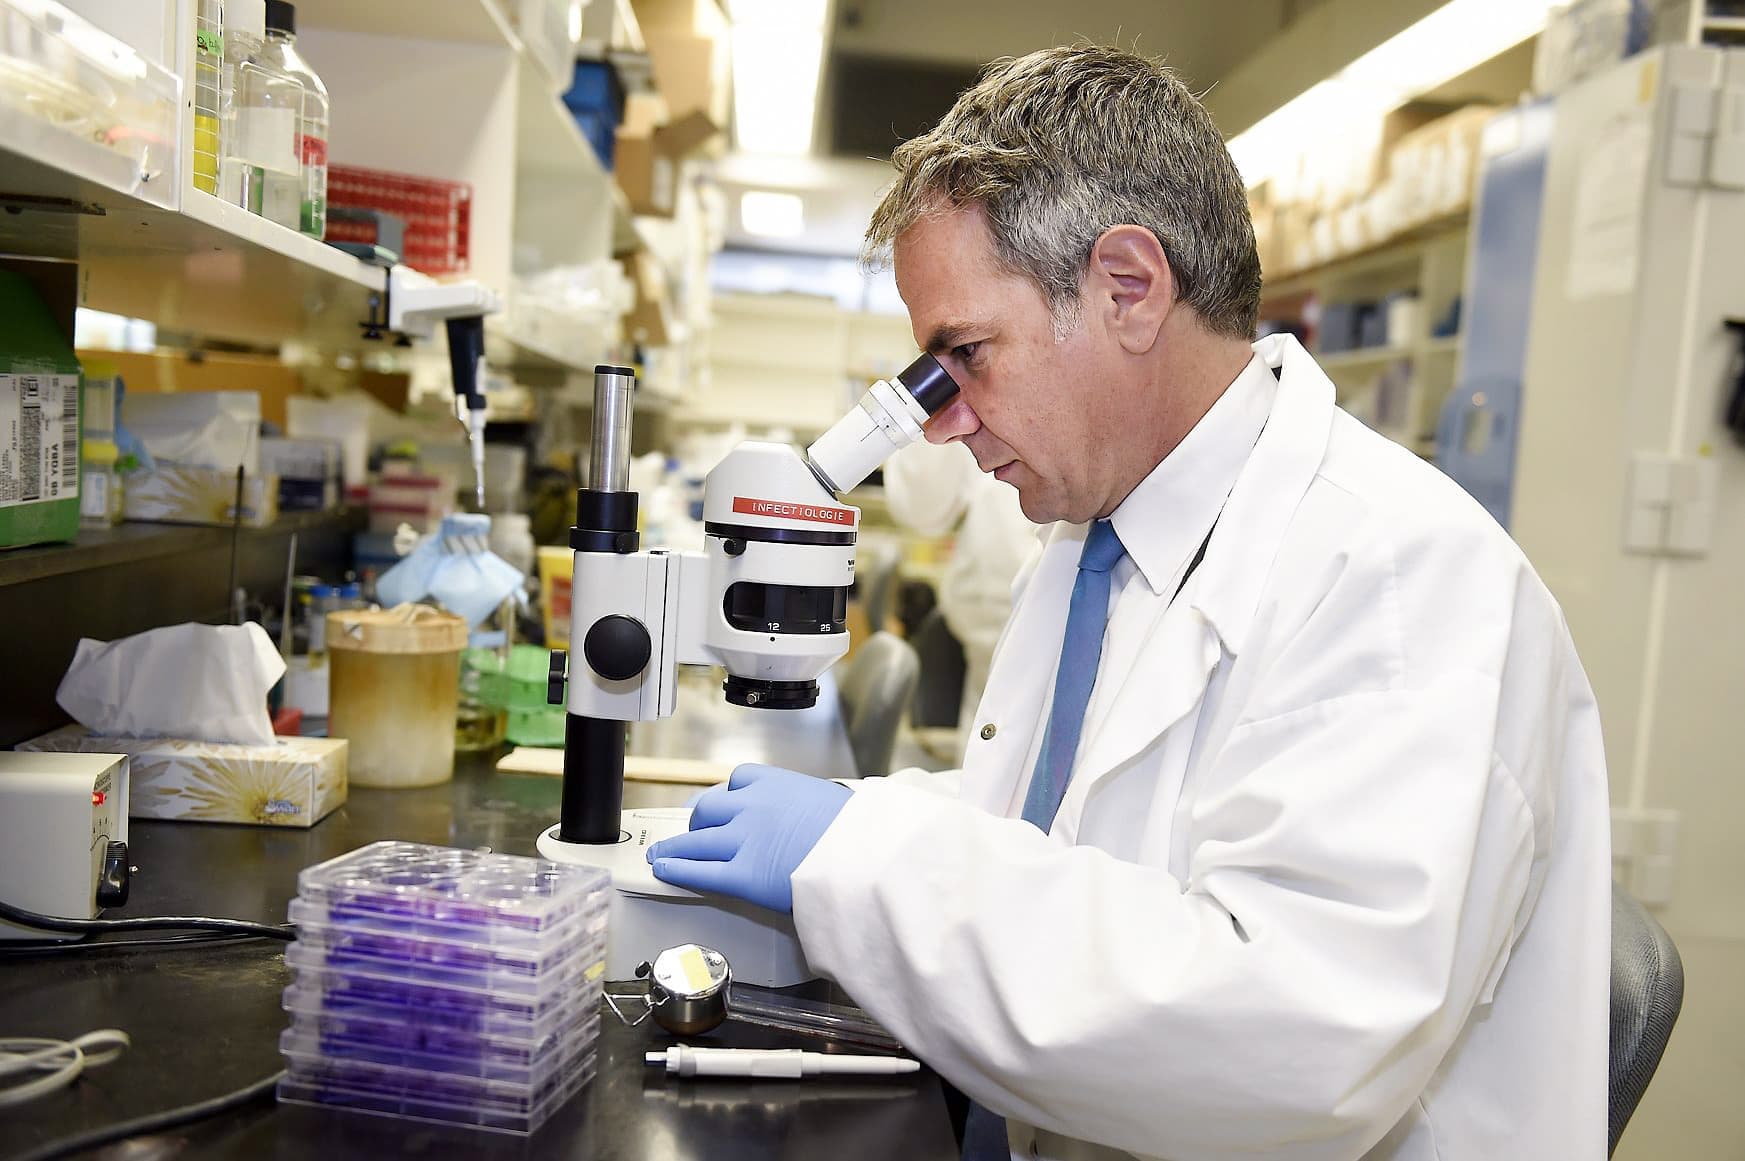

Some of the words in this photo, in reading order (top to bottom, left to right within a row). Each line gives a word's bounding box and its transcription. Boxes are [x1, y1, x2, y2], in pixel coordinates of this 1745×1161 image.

[752, 502, 844, 520] INFECTIOLOGIE
[767, 622, 780, 631] 12
[820, 623, 831, 632] 25
